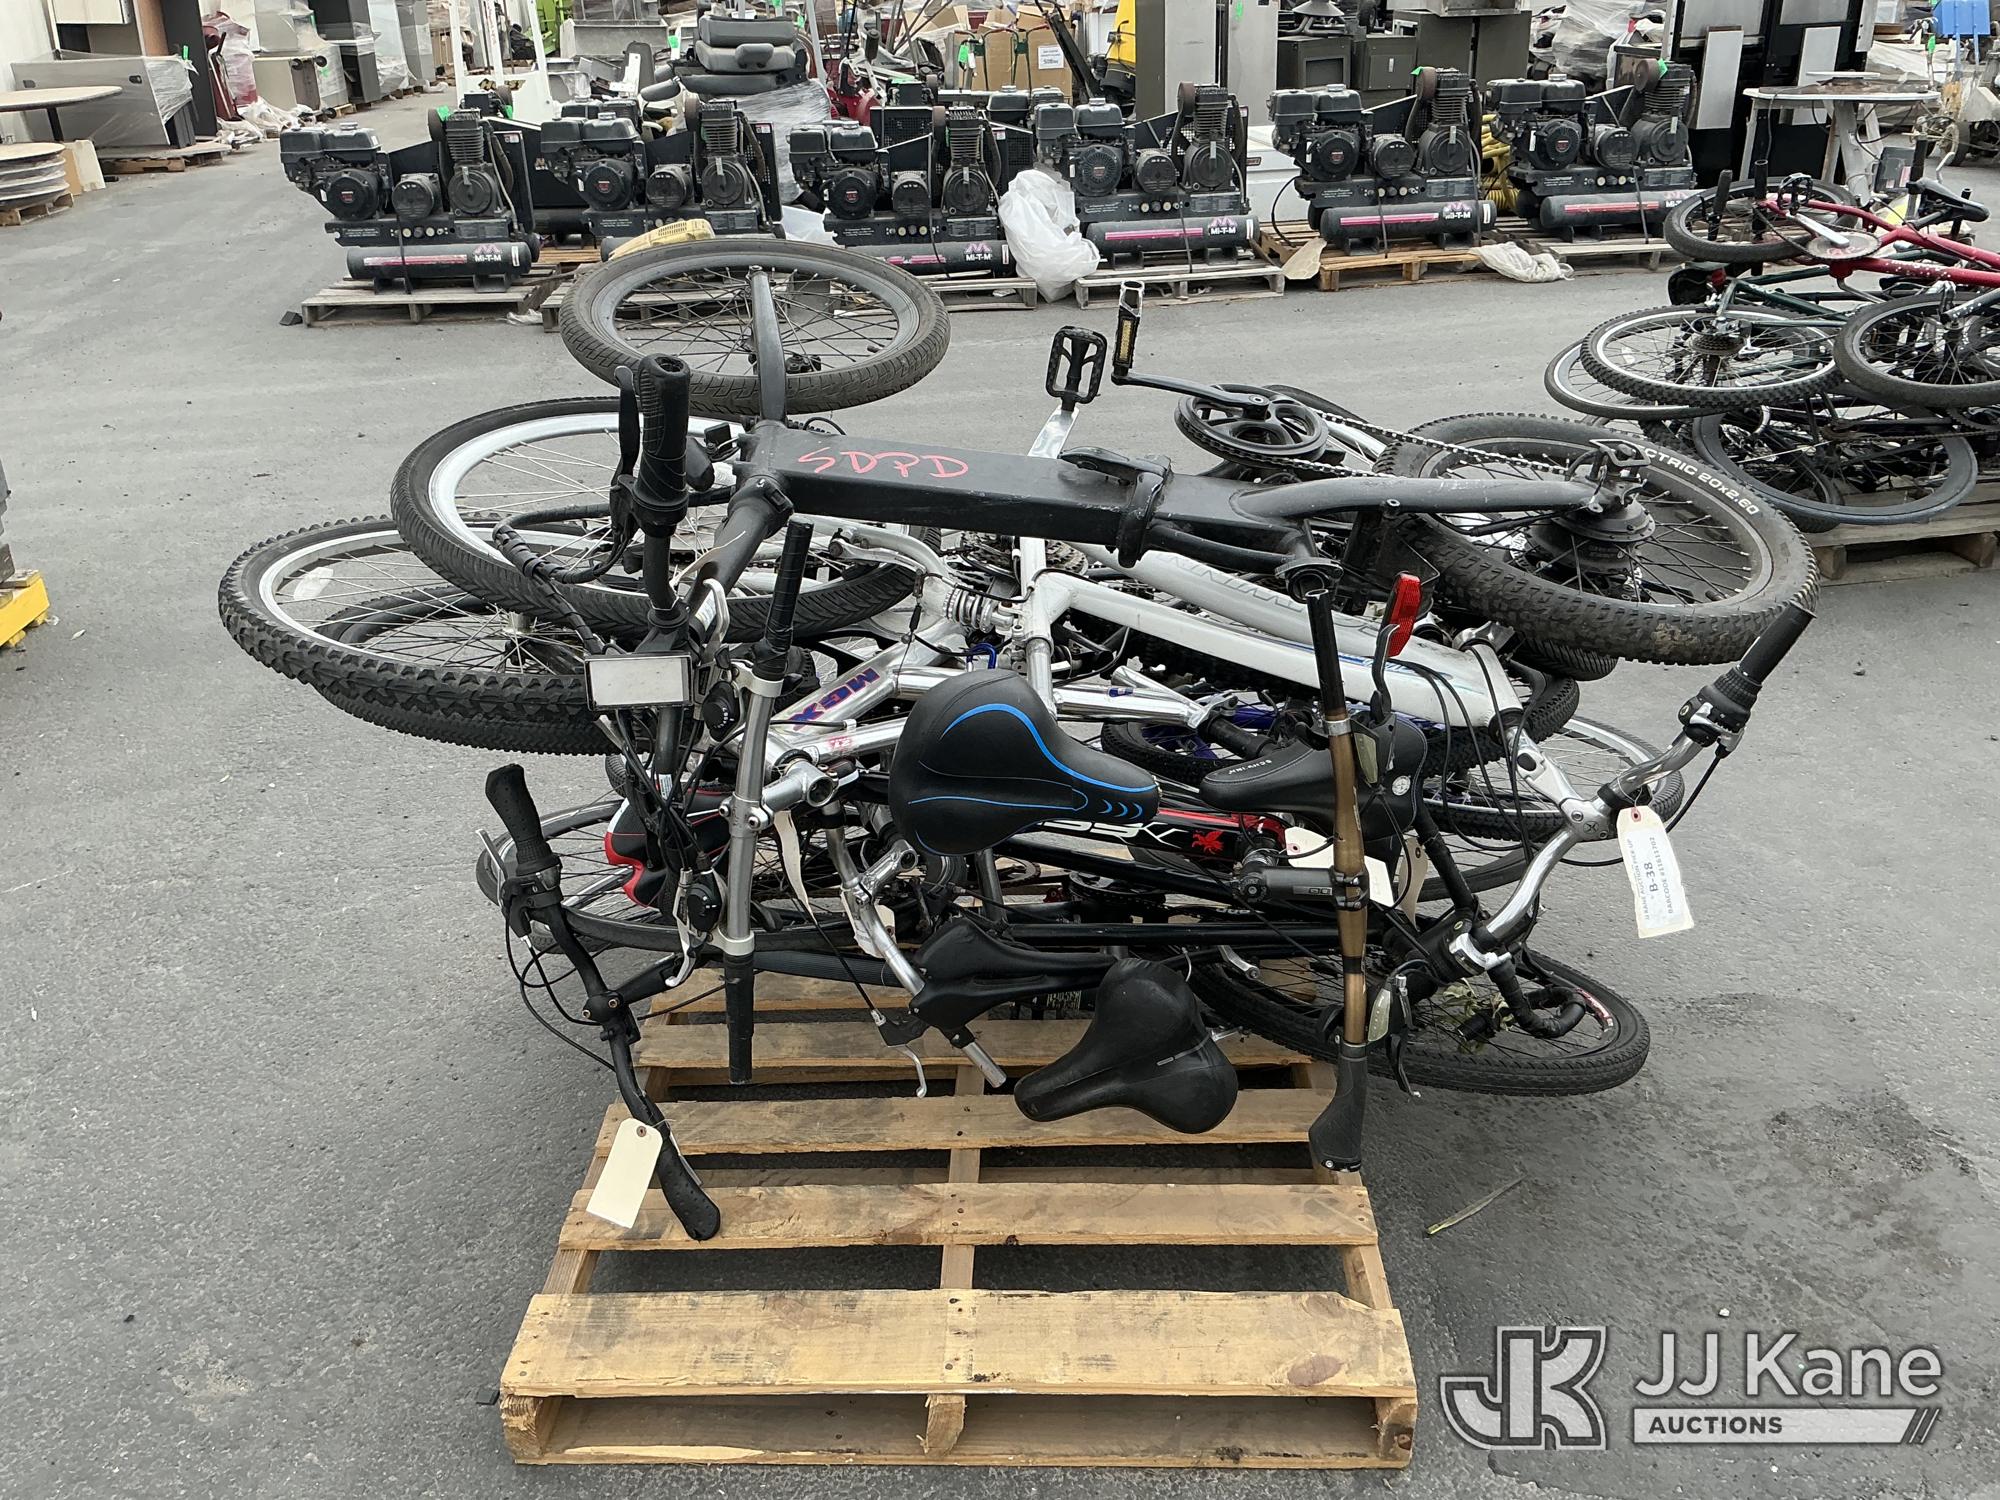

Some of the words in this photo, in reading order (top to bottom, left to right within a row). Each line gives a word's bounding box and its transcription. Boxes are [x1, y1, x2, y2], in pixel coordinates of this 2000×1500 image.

[798, 446, 969, 478] SDPD
[1644, 862, 1659, 893] B-38
[1661, 878, 1673, 914] BARCODE
